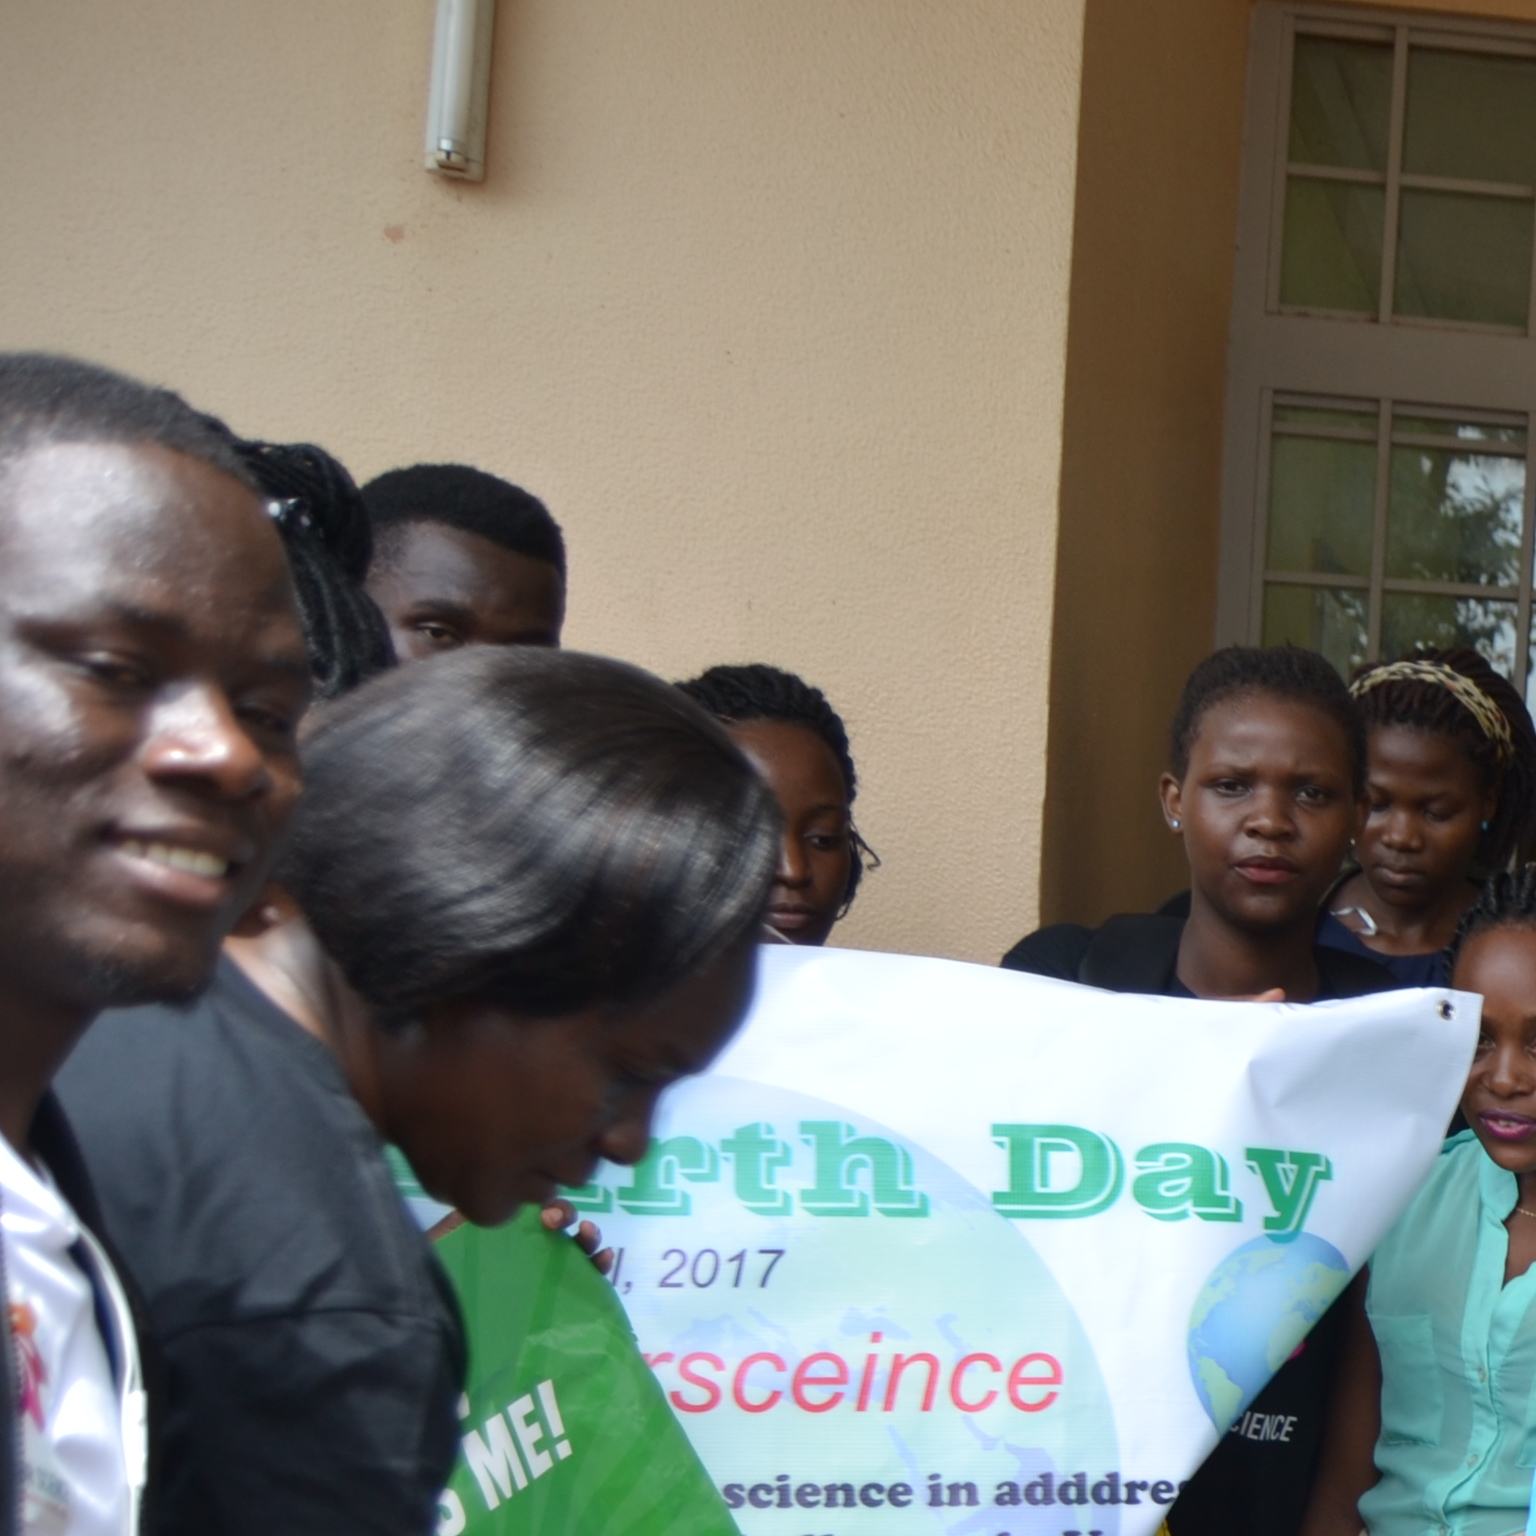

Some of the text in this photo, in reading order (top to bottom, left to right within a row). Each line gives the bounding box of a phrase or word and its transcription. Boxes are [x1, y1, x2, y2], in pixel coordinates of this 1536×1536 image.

[990, 1123, 1334, 1244] Day
[658, 1248, 786, 1288] 2017
[461, 1378, 573, 1512] ME!
[1230, 1411, 1298, 1442] IENCE
[722, 1471, 1186, 1509] science in adddre
